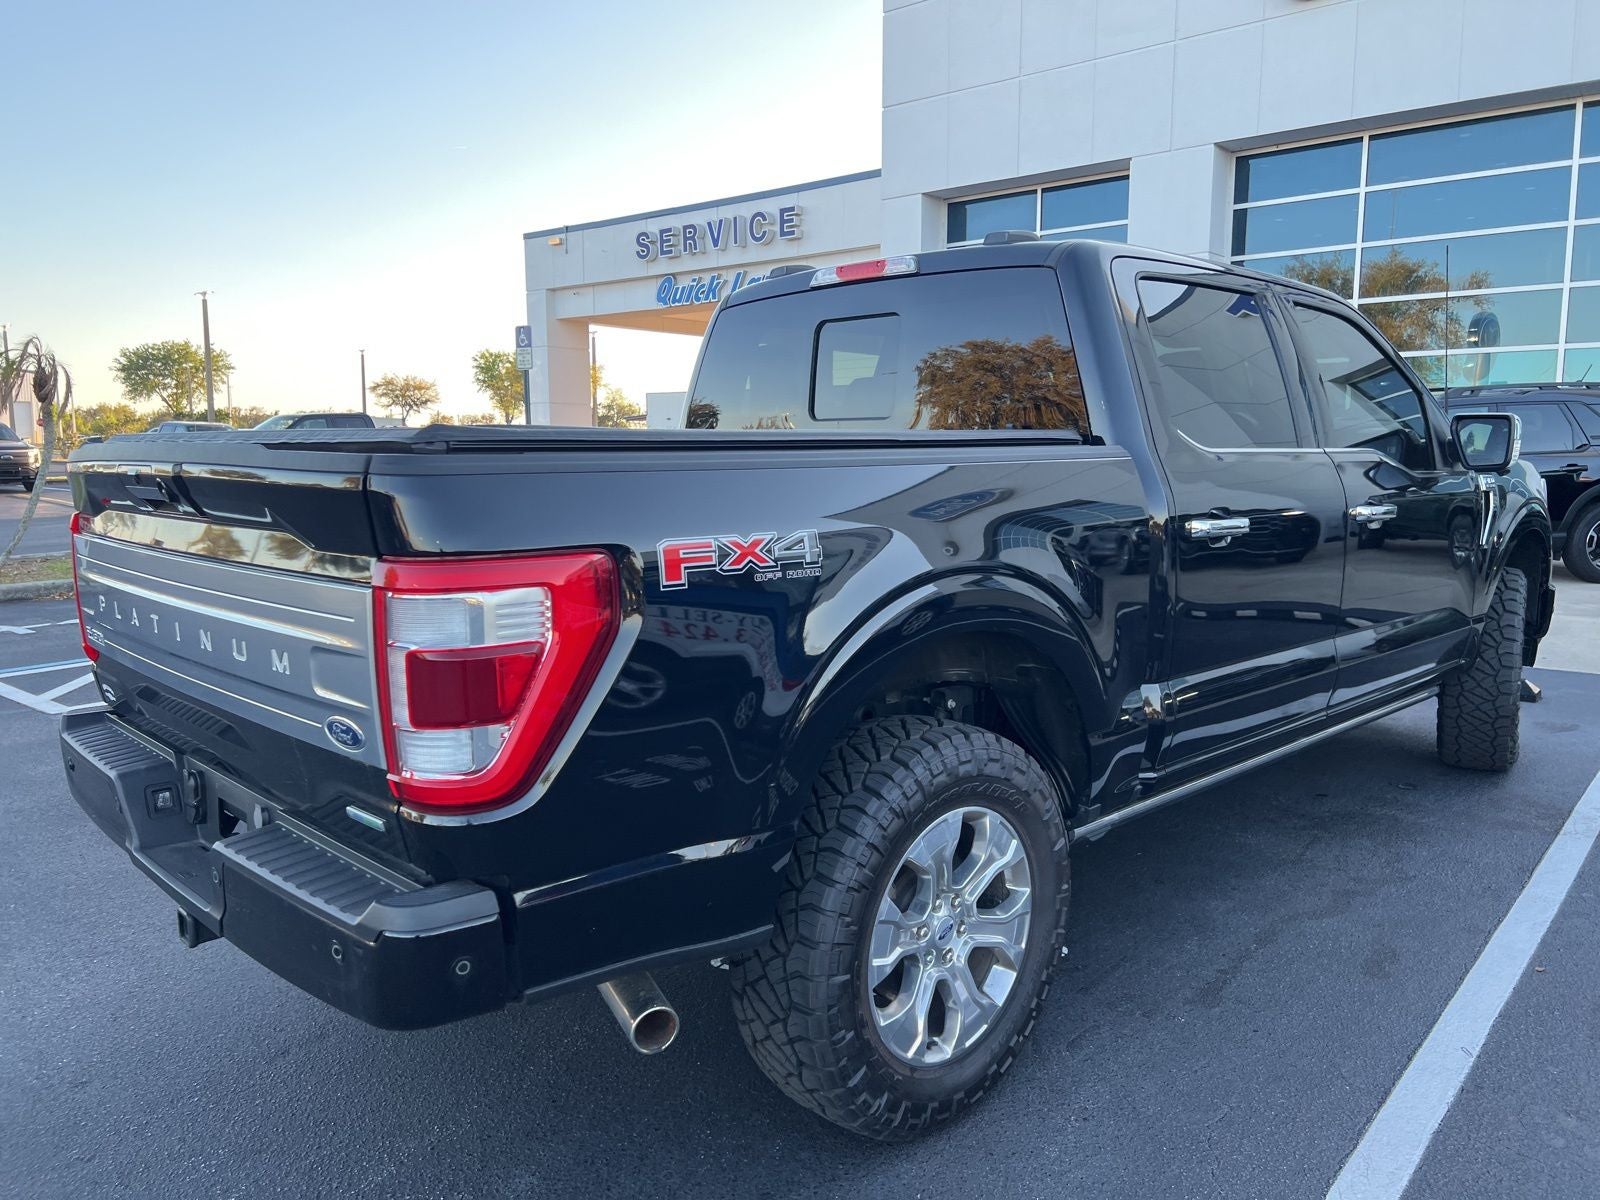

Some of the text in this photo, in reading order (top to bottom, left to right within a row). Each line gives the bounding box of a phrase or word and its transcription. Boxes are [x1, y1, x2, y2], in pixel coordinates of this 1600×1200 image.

[635, 205, 802, 262] SERVICE
[656, 274, 725, 308] Quick
[656, 529, 823, 592] FX4
[754, 573, 783, 582] OFF
[98, 595, 291, 675] PLATINUM
